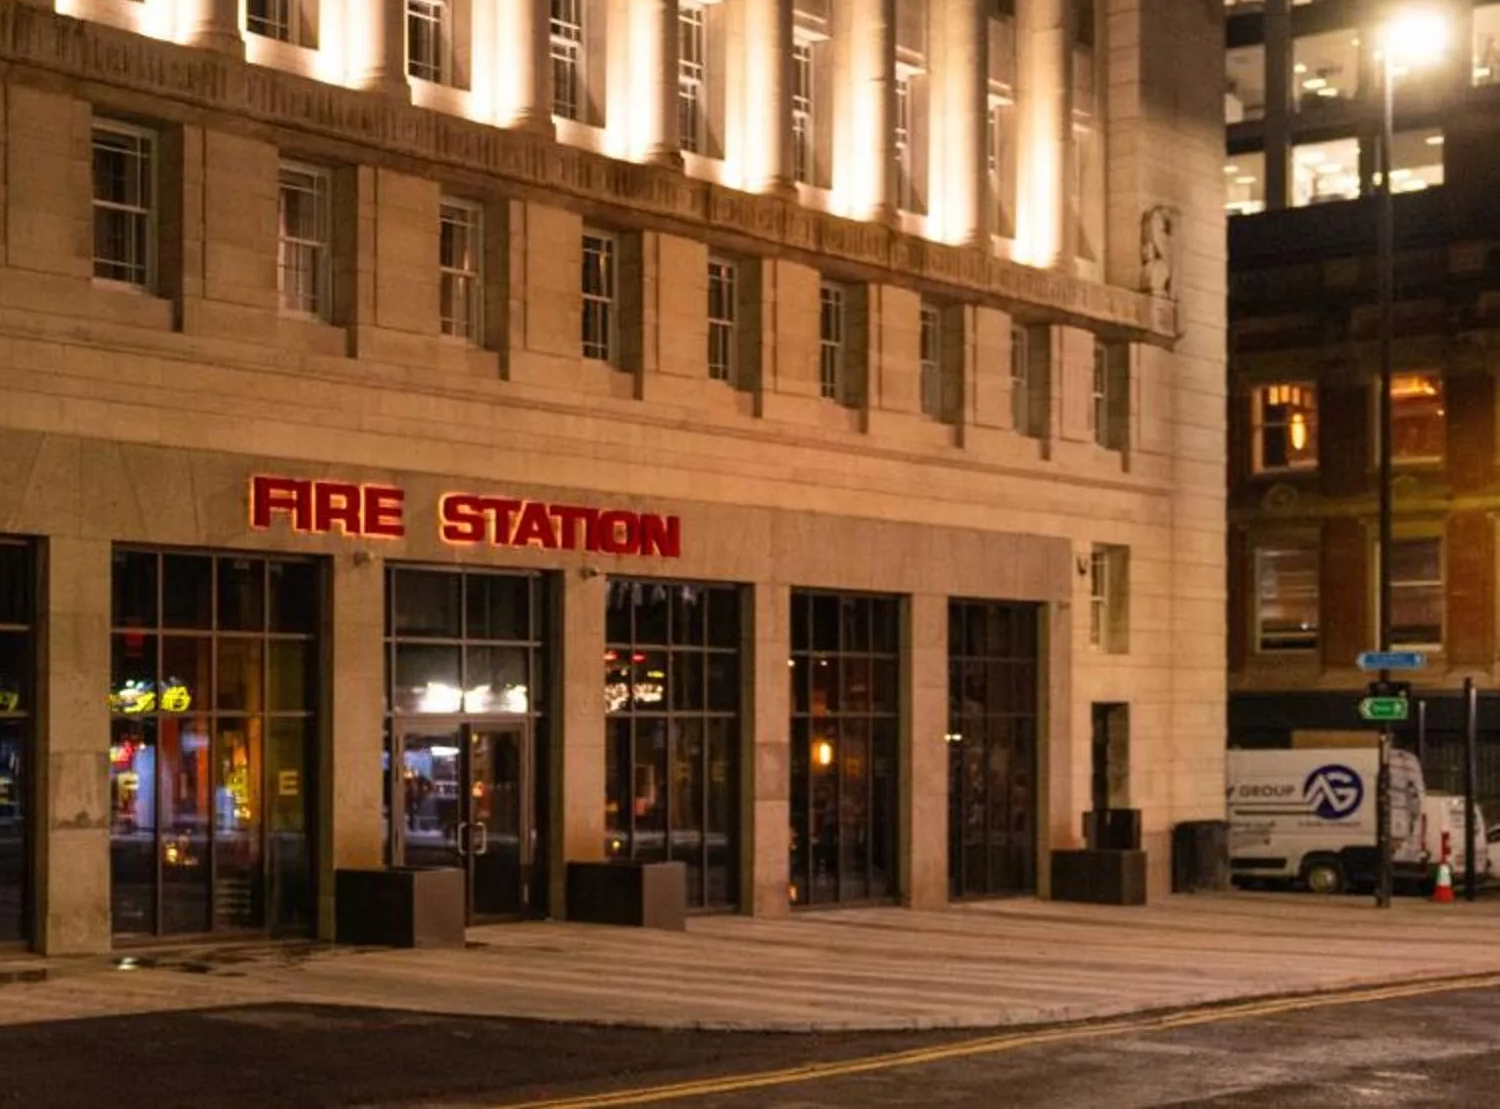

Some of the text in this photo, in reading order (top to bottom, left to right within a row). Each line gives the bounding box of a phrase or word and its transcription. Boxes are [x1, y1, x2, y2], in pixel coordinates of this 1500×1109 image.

[251, 474, 681, 558] FIRE STATION
[1238, 784, 1295, 798] GROUP
